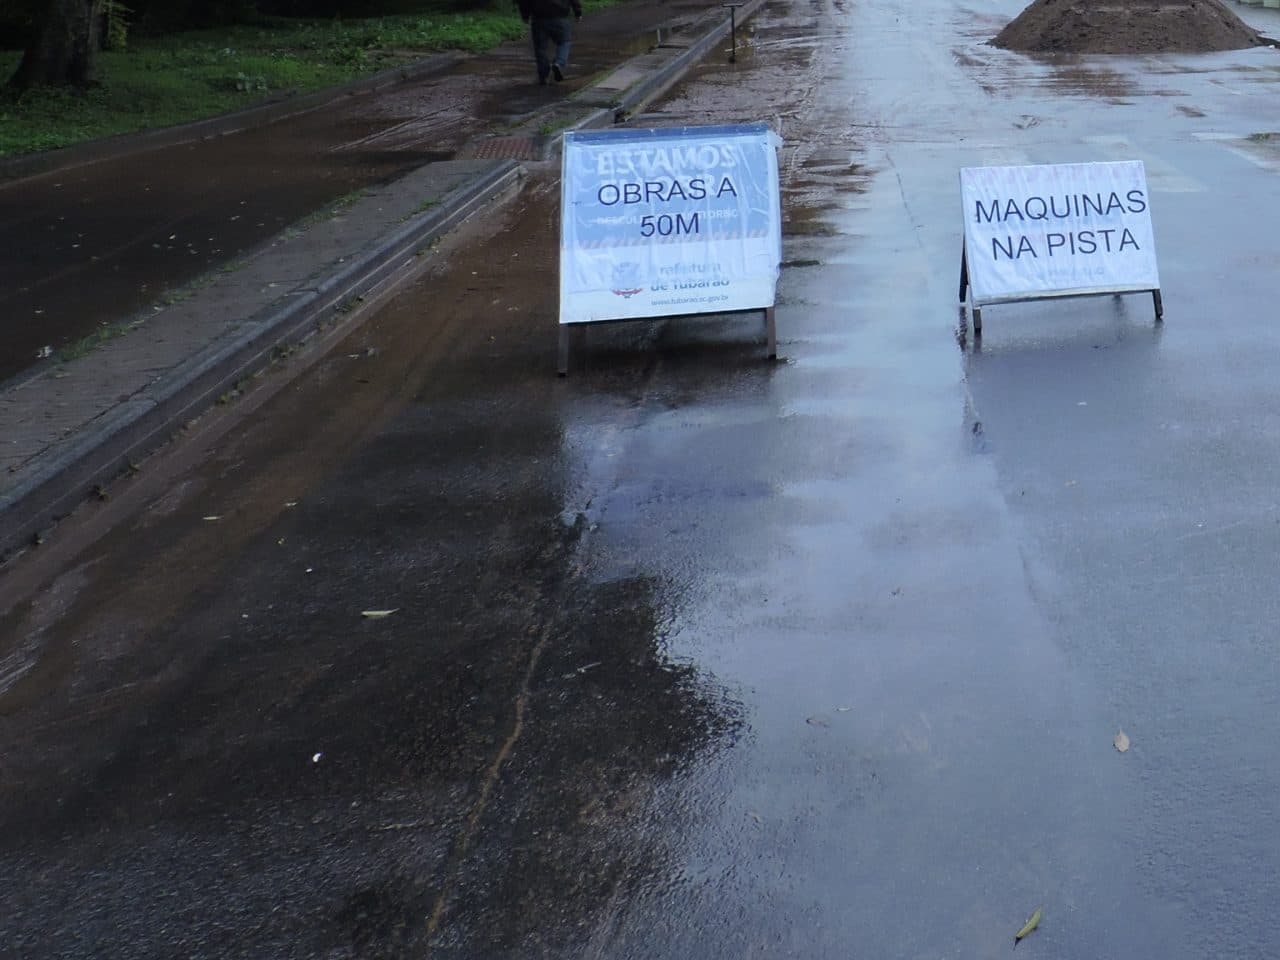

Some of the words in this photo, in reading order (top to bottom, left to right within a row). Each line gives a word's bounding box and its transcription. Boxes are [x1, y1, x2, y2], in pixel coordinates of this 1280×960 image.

[597, 178, 707, 206] OBRAS
[716, 176, 738, 199] A
[975, 190, 1147, 224] MAQUINAS
[640, 212, 700, 238] 50M
[992, 235, 1038, 261] NA
[1046, 228, 1141, 257] PISTA
